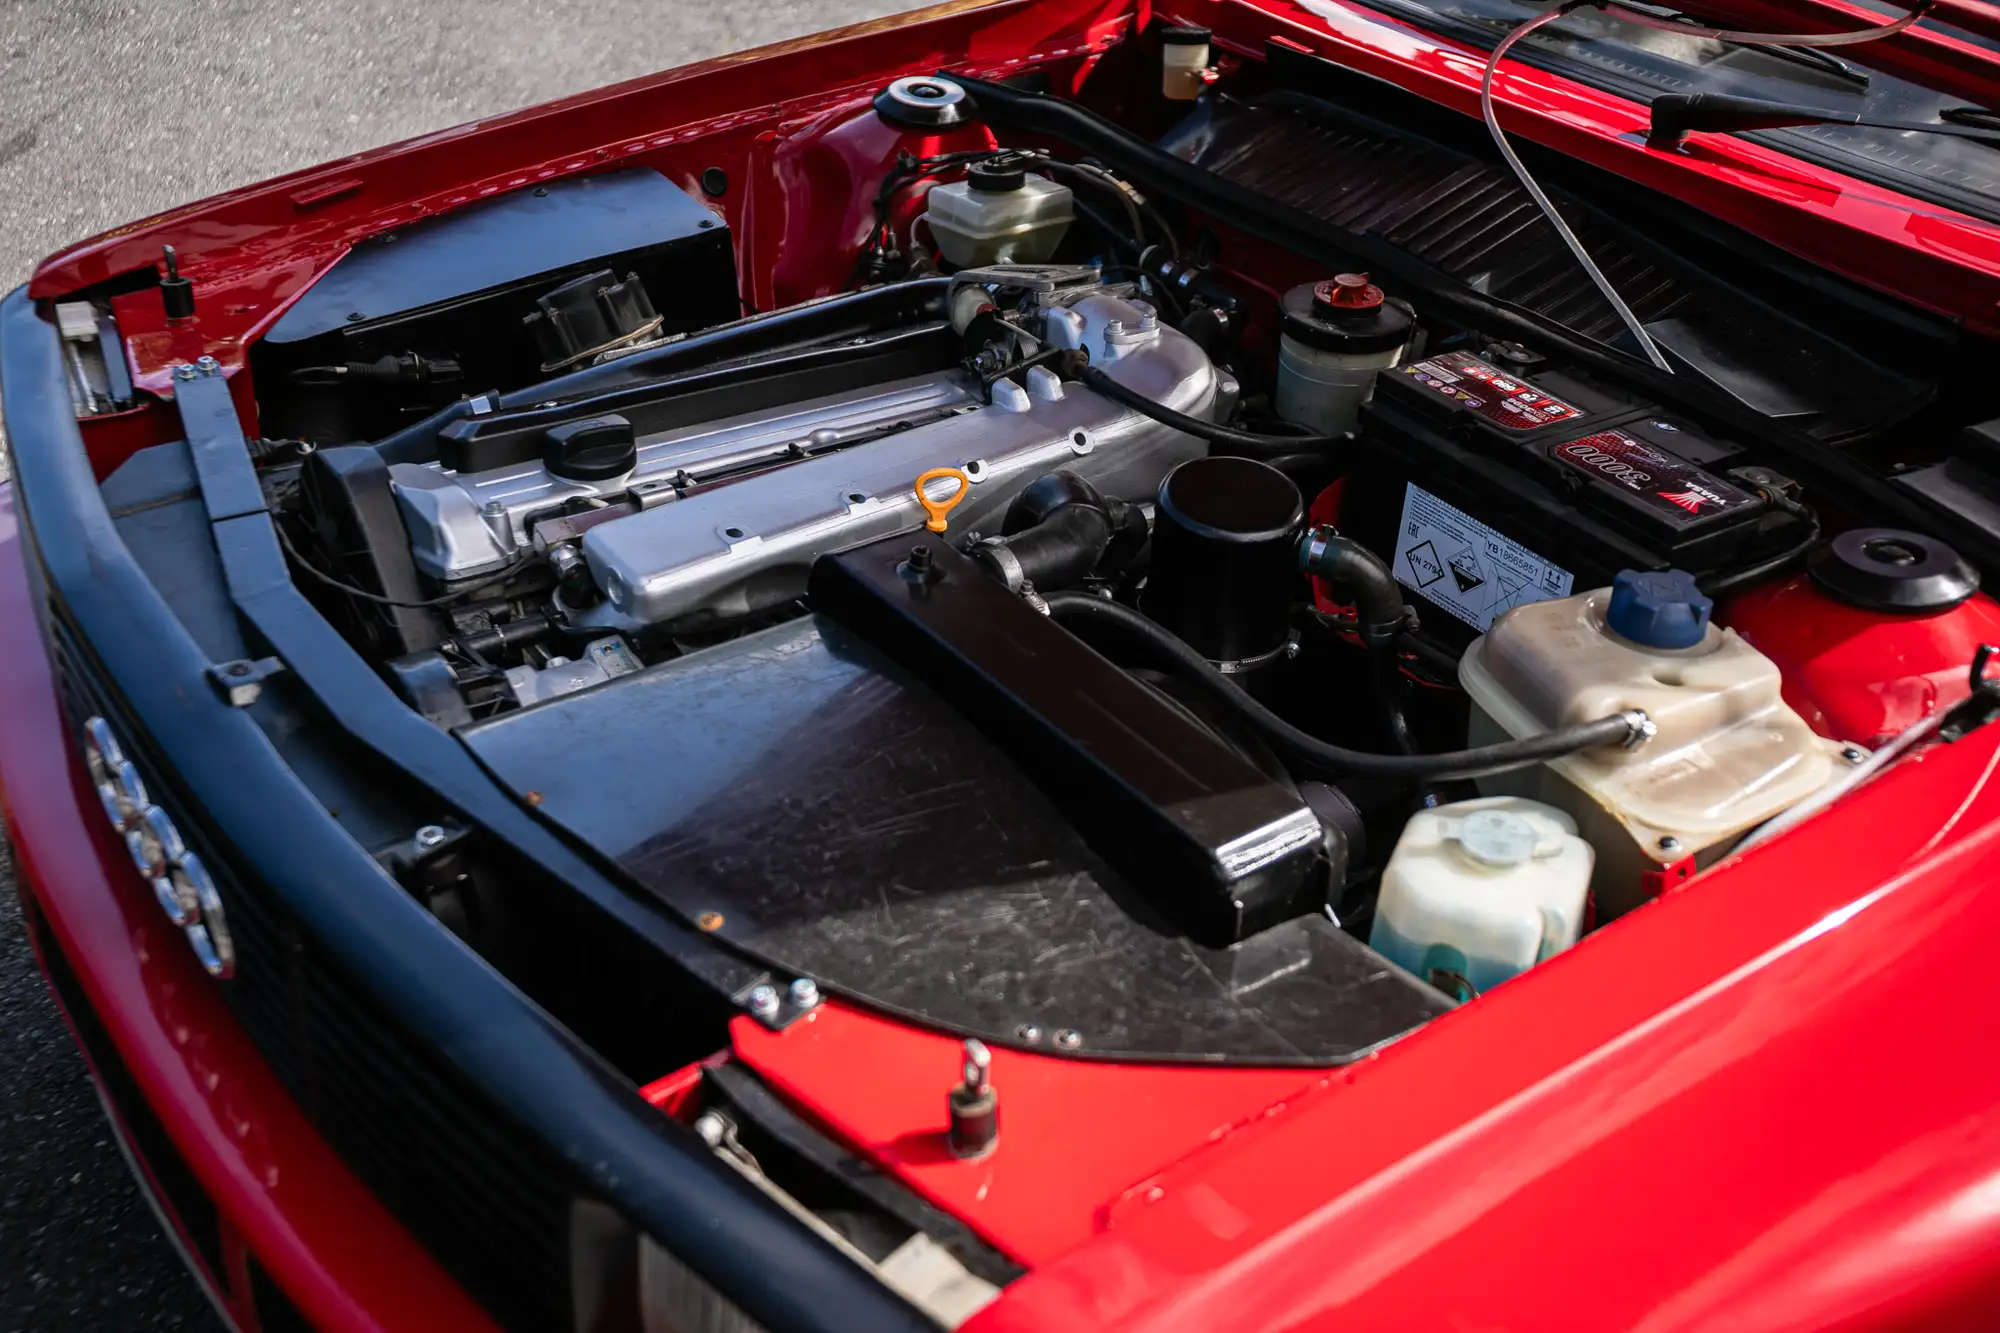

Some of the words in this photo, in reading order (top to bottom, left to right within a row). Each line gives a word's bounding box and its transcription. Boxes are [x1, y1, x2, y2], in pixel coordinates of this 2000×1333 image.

[1541, 405, 1562, 415] 12
[1565, 444, 1652, 484] 3000
[1684, 481, 1728, 505] YUASA
[1408, 551, 1421, 566] UN
[1422, 559, 1441, 577] 2794
